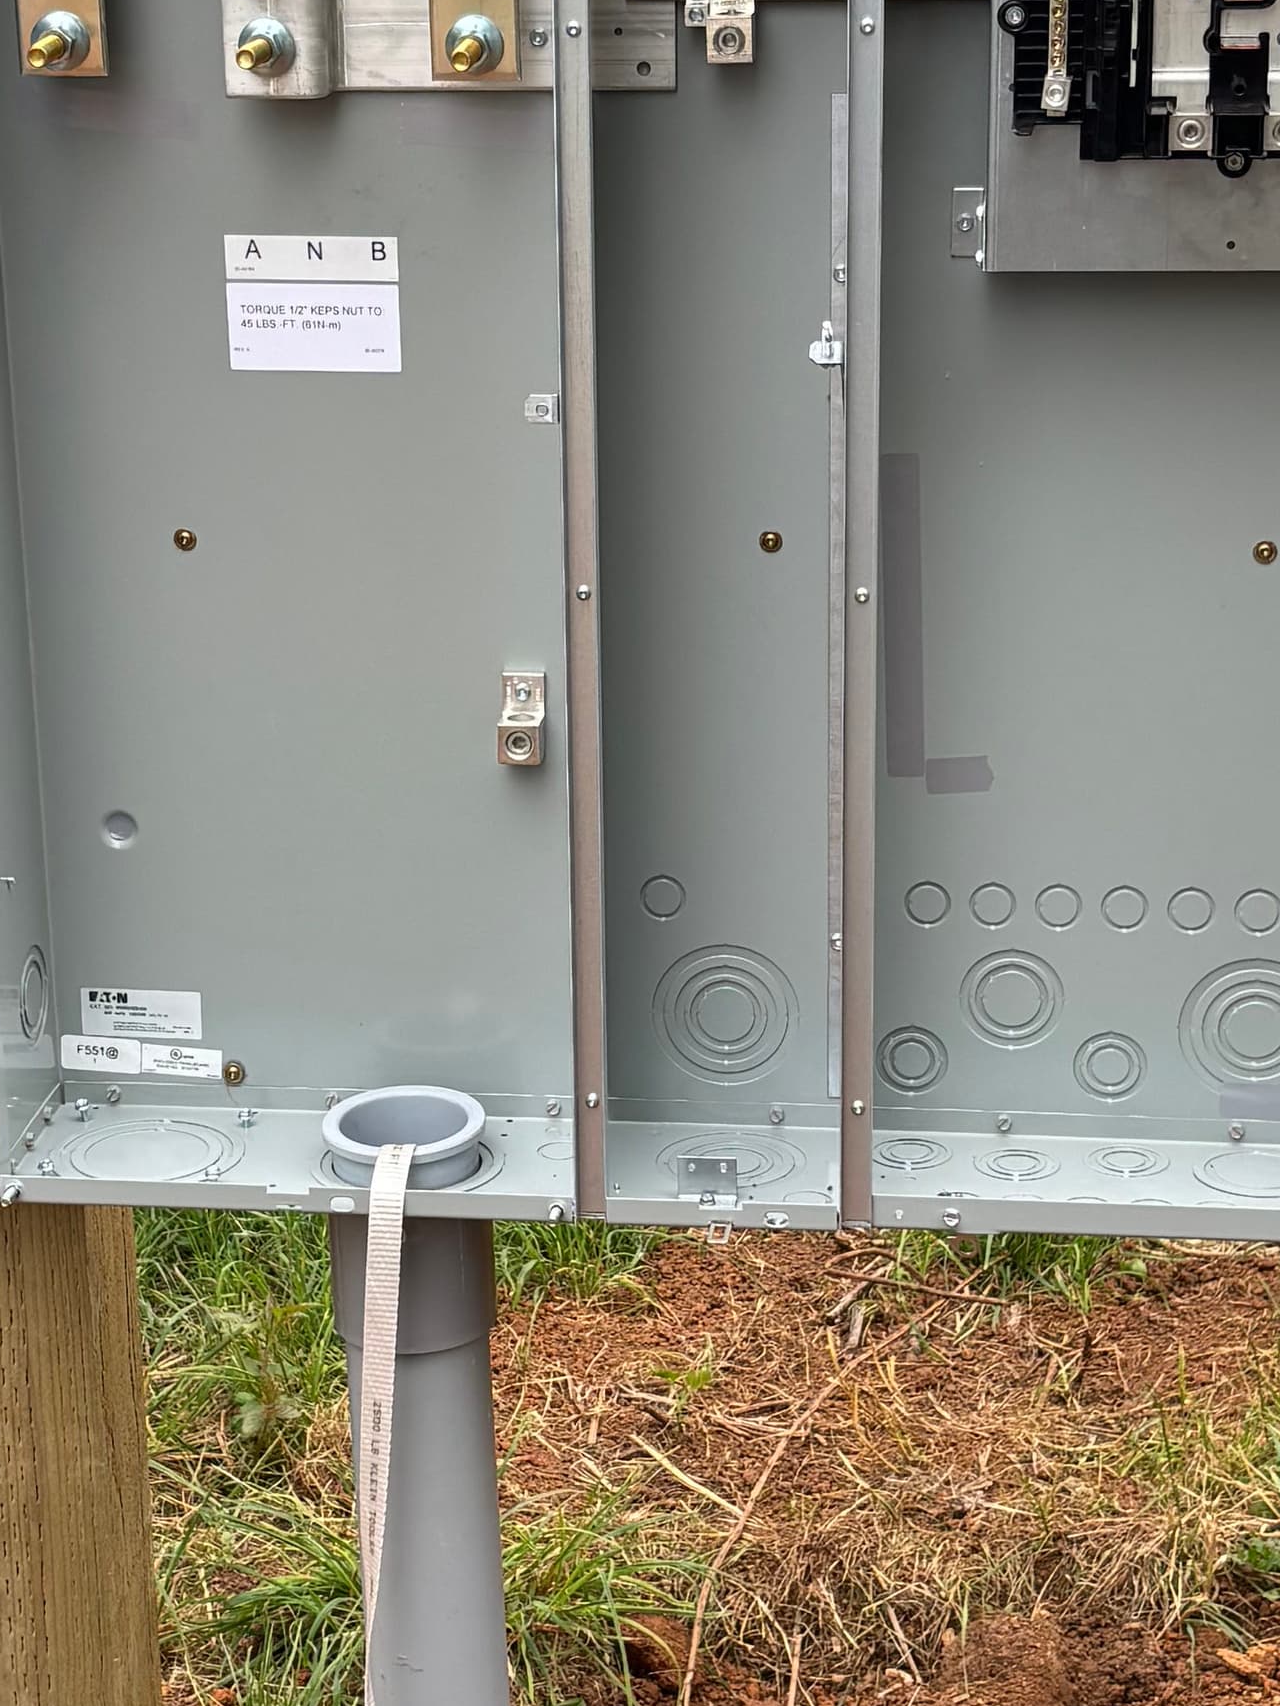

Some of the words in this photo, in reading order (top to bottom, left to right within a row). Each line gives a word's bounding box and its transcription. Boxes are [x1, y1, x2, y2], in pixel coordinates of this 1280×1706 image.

[244, 239, 262, 259] A
[307, 241, 323, 260] N
[371, 241, 387, 261] B
[240, 304, 286, 315] TORQUE
[310, 306, 340, 316] KEPS
[342, 306, 364, 316] NUT
[240, 319, 254, 329] 45
[372, 1401, 383, 1433] 2500
[368, 1463, 378, 1502] KLEIN
